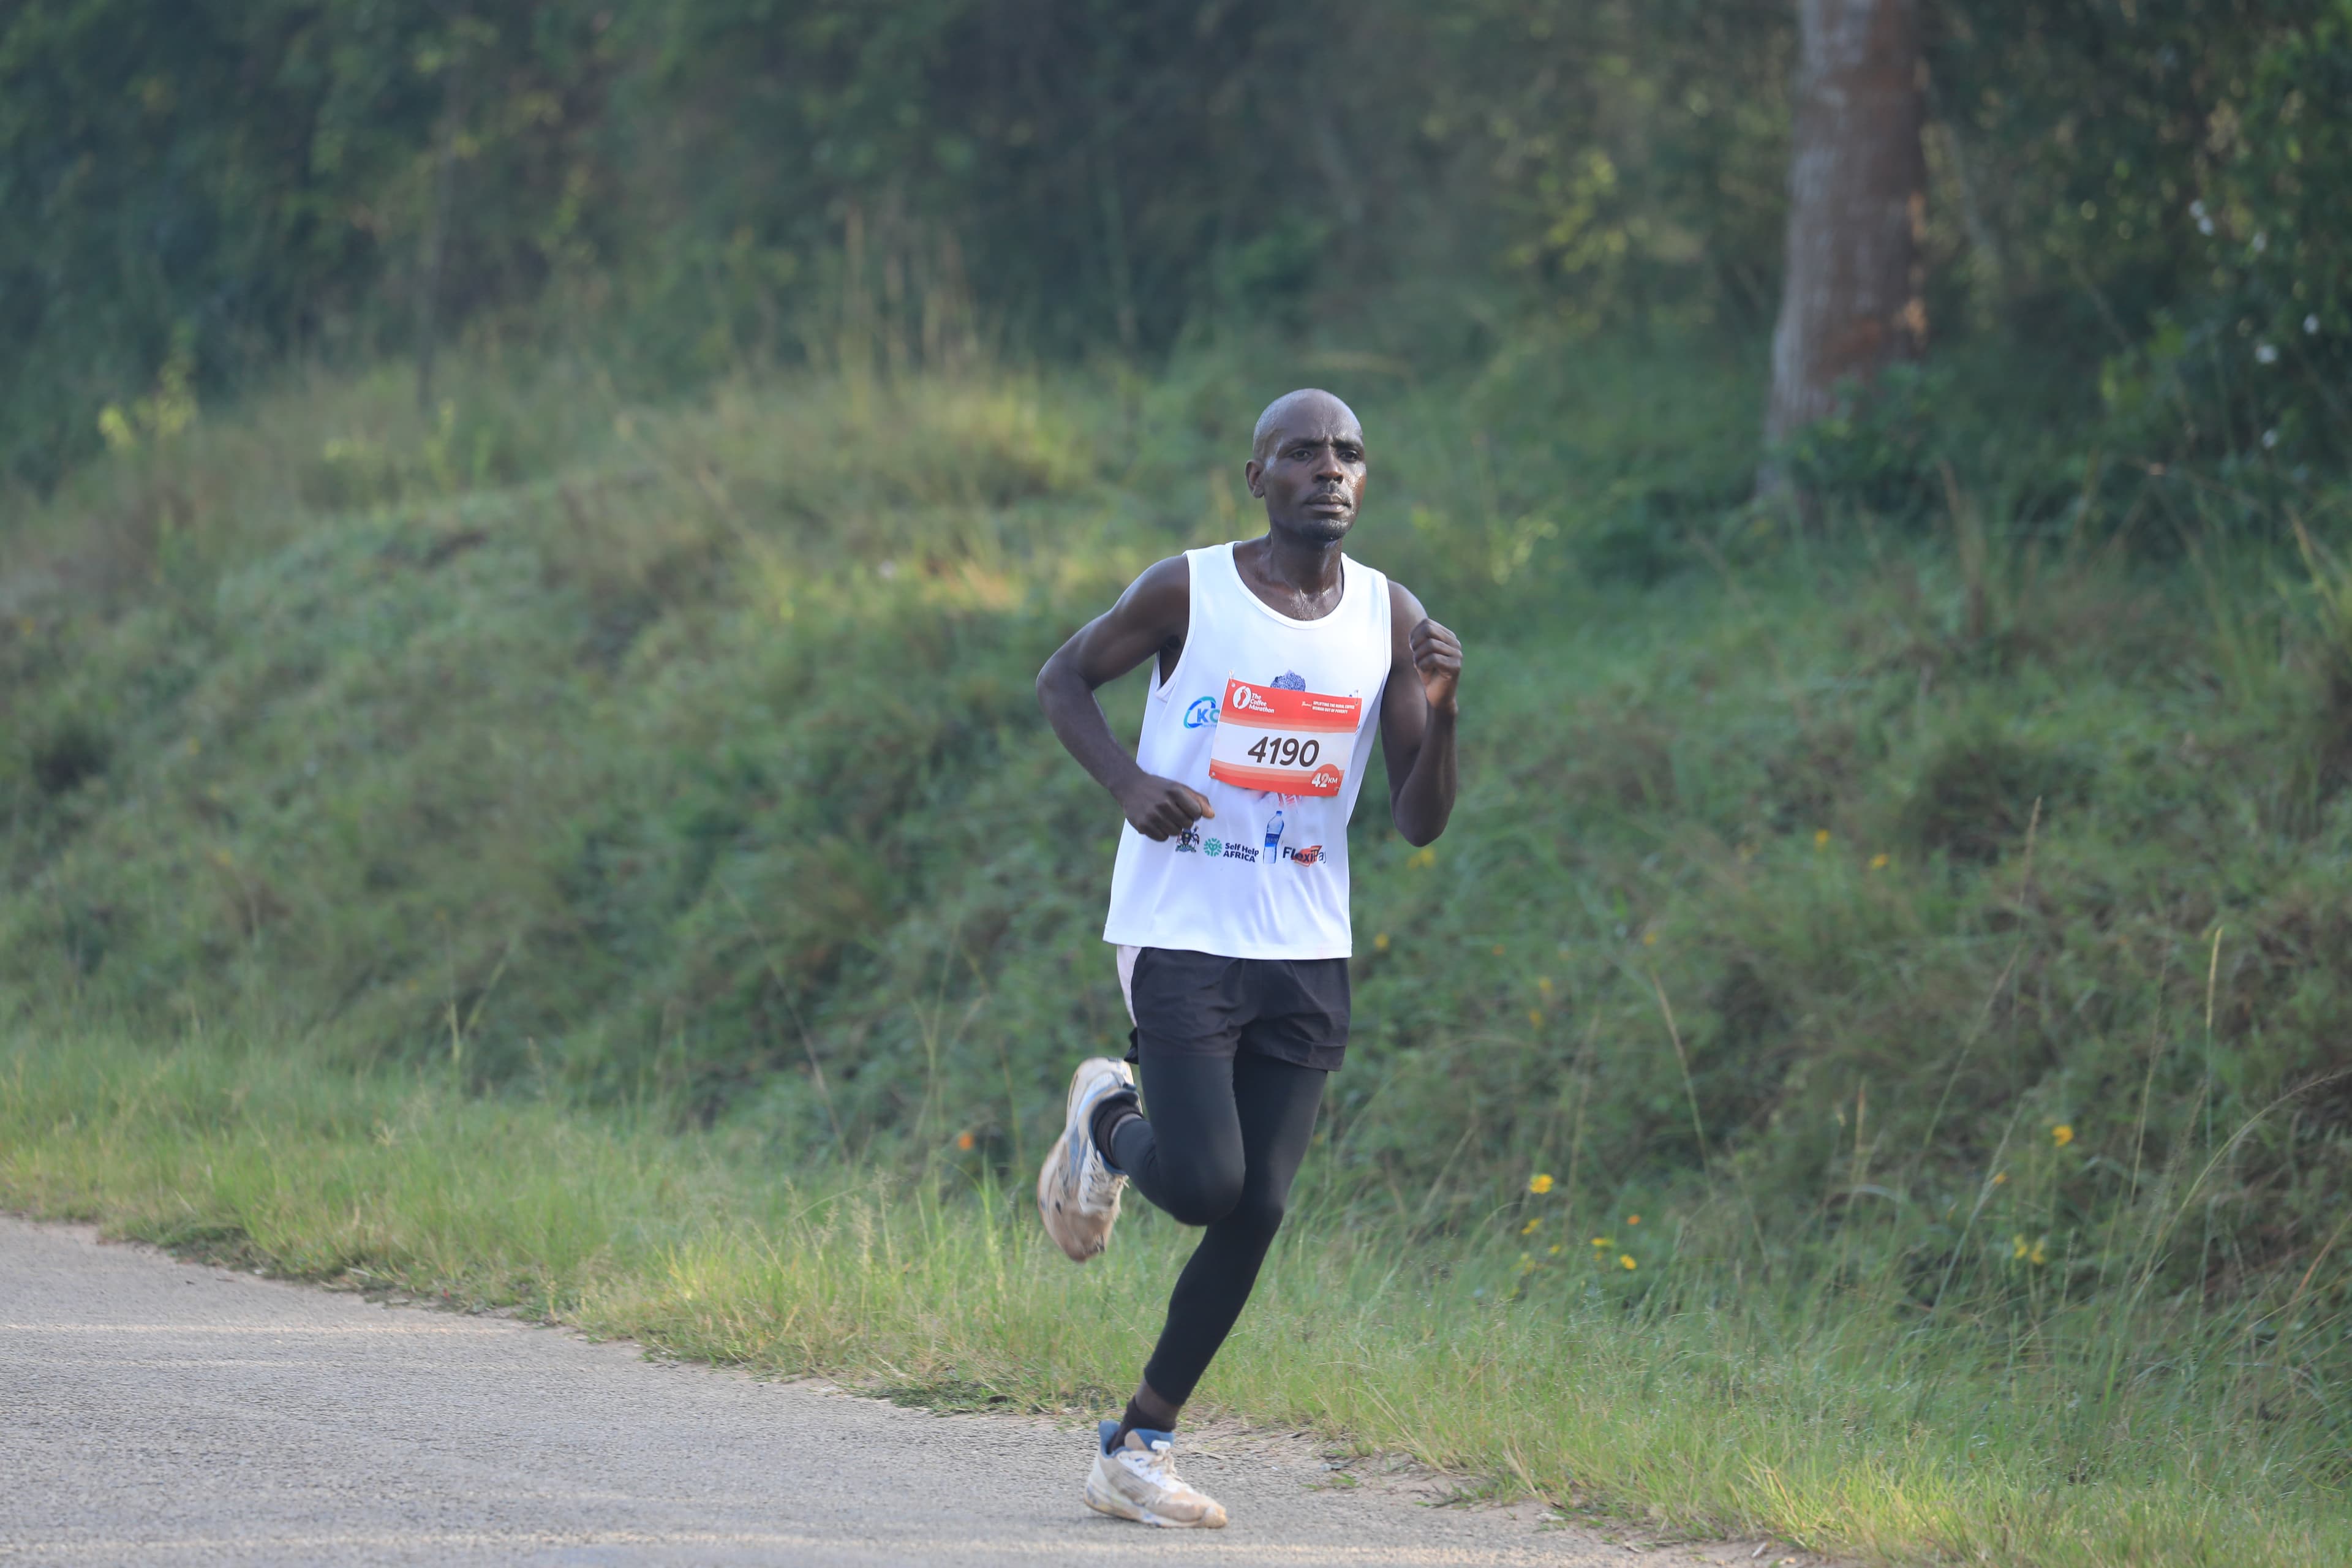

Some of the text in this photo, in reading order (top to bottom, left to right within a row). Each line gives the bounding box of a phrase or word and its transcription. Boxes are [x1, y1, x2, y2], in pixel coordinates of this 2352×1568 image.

[1248, 704, 1275, 714] Marathon
[1247, 736, 1319, 767] 4190
[1223, 850, 1256, 862] AFRICA
[1242, 845, 1259, 857] Help
